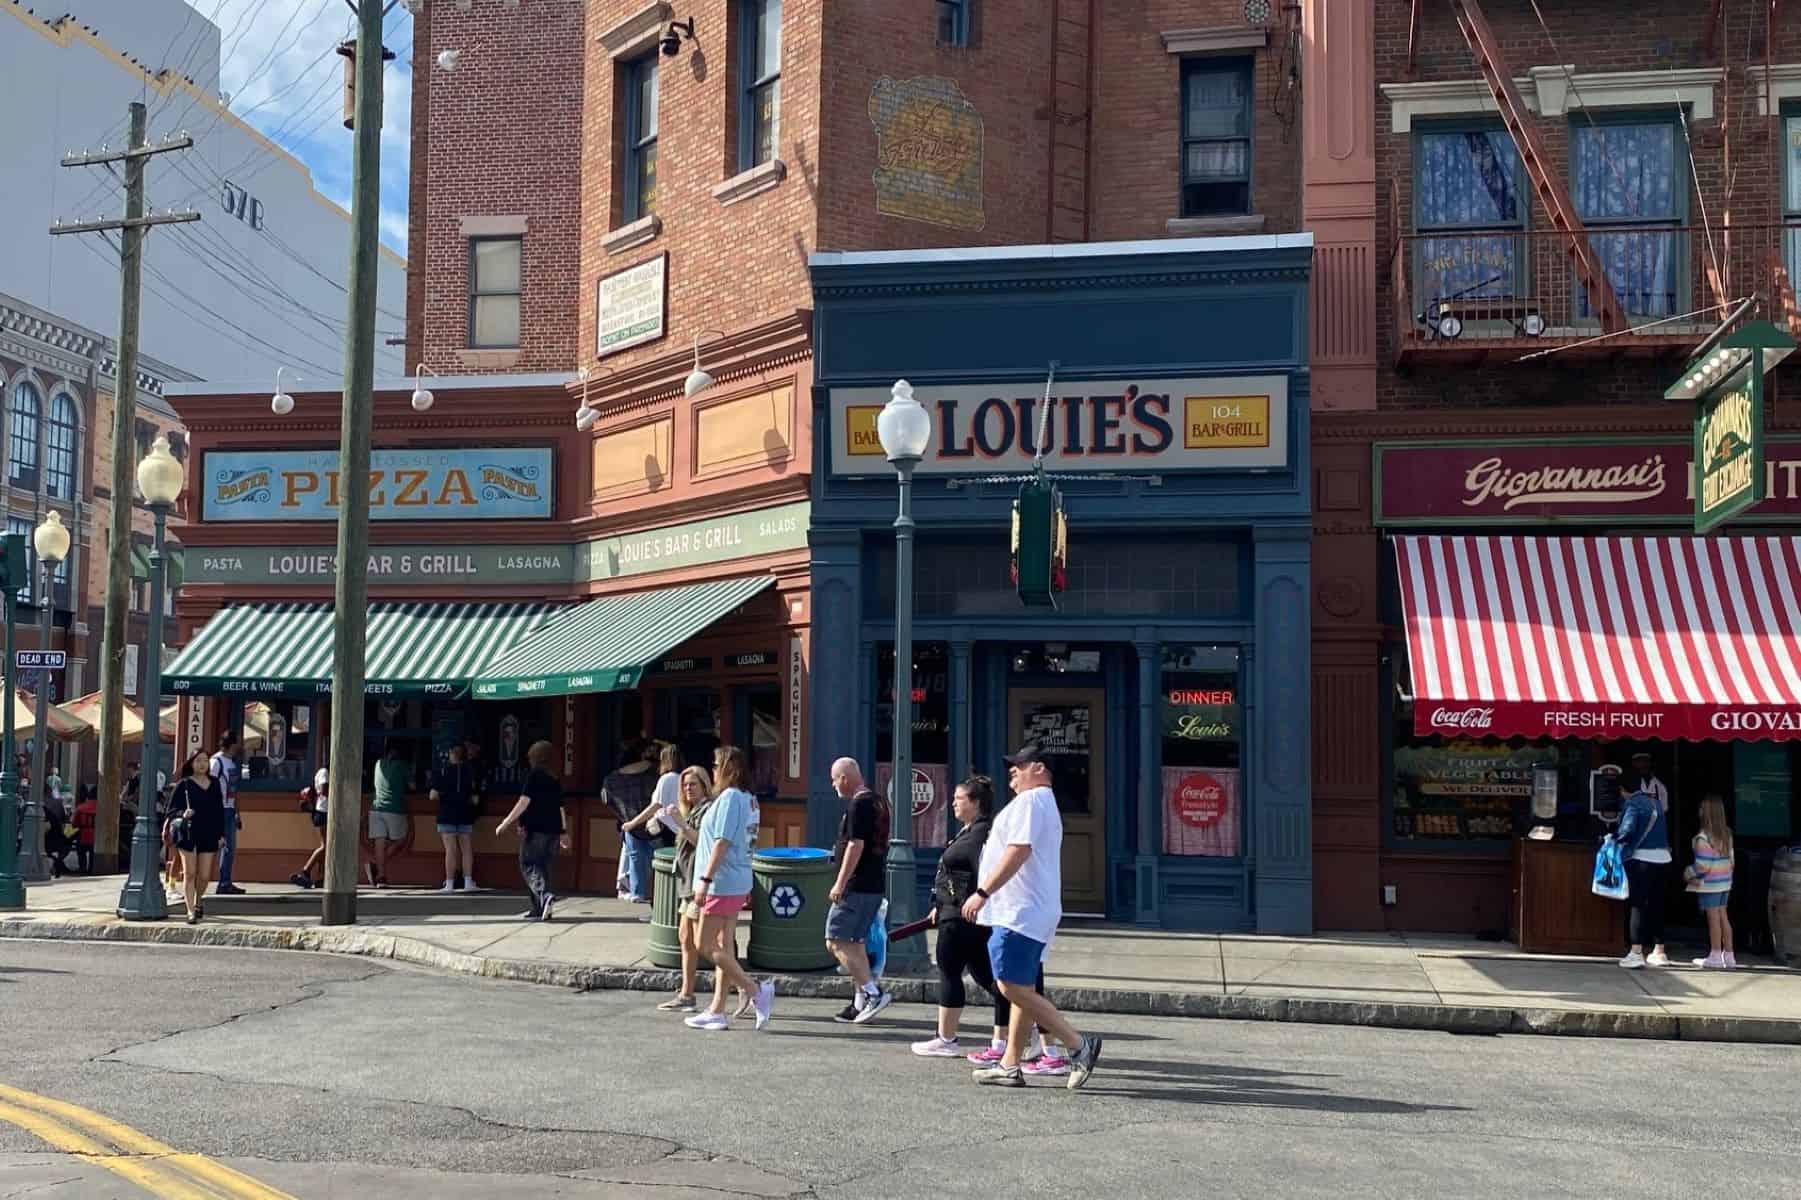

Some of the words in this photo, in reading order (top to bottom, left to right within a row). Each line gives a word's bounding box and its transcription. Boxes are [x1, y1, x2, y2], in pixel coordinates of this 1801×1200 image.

[1212, 404, 1241, 419] 104
[935, 384, 1173, 460] LOUIE'S
[216, 471, 269, 500] PASTA
[482, 468, 538, 497] PASTA
[1461, 454, 1666, 511] Giovannasi's
[759, 516, 798, 538] SALADS
[665, 532, 690, 556] BAR
[693, 530, 702, 552] &
[705, 524, 742, 550] GRILL
[203, 557, 243, 570] PASTA
[367, 555, 392, 574] AR
[400, 554, 412, 573] &
[419, 555, 477, 574] GRILL
[497, 556, 561, 569] LASAGNA
[20, 654, 41, 665] DEAD
[44, 654, 62, 665] END
[222, 681, 249, 691] BEER
[259, 682, 285, 692] WINE
[424, 683, 452, 693] PIZZA
[1170, 690, 1233, 705] DINNER
[792, 651, 800, 764] SPAGHETTI
[1171, 714, 1231, 740] Louie's
[1544, 711, 1604, 727] FRESH
[1610, 712, 1664, 728] FRUIT
[1469, 784, 1529, 795] DELIVER
